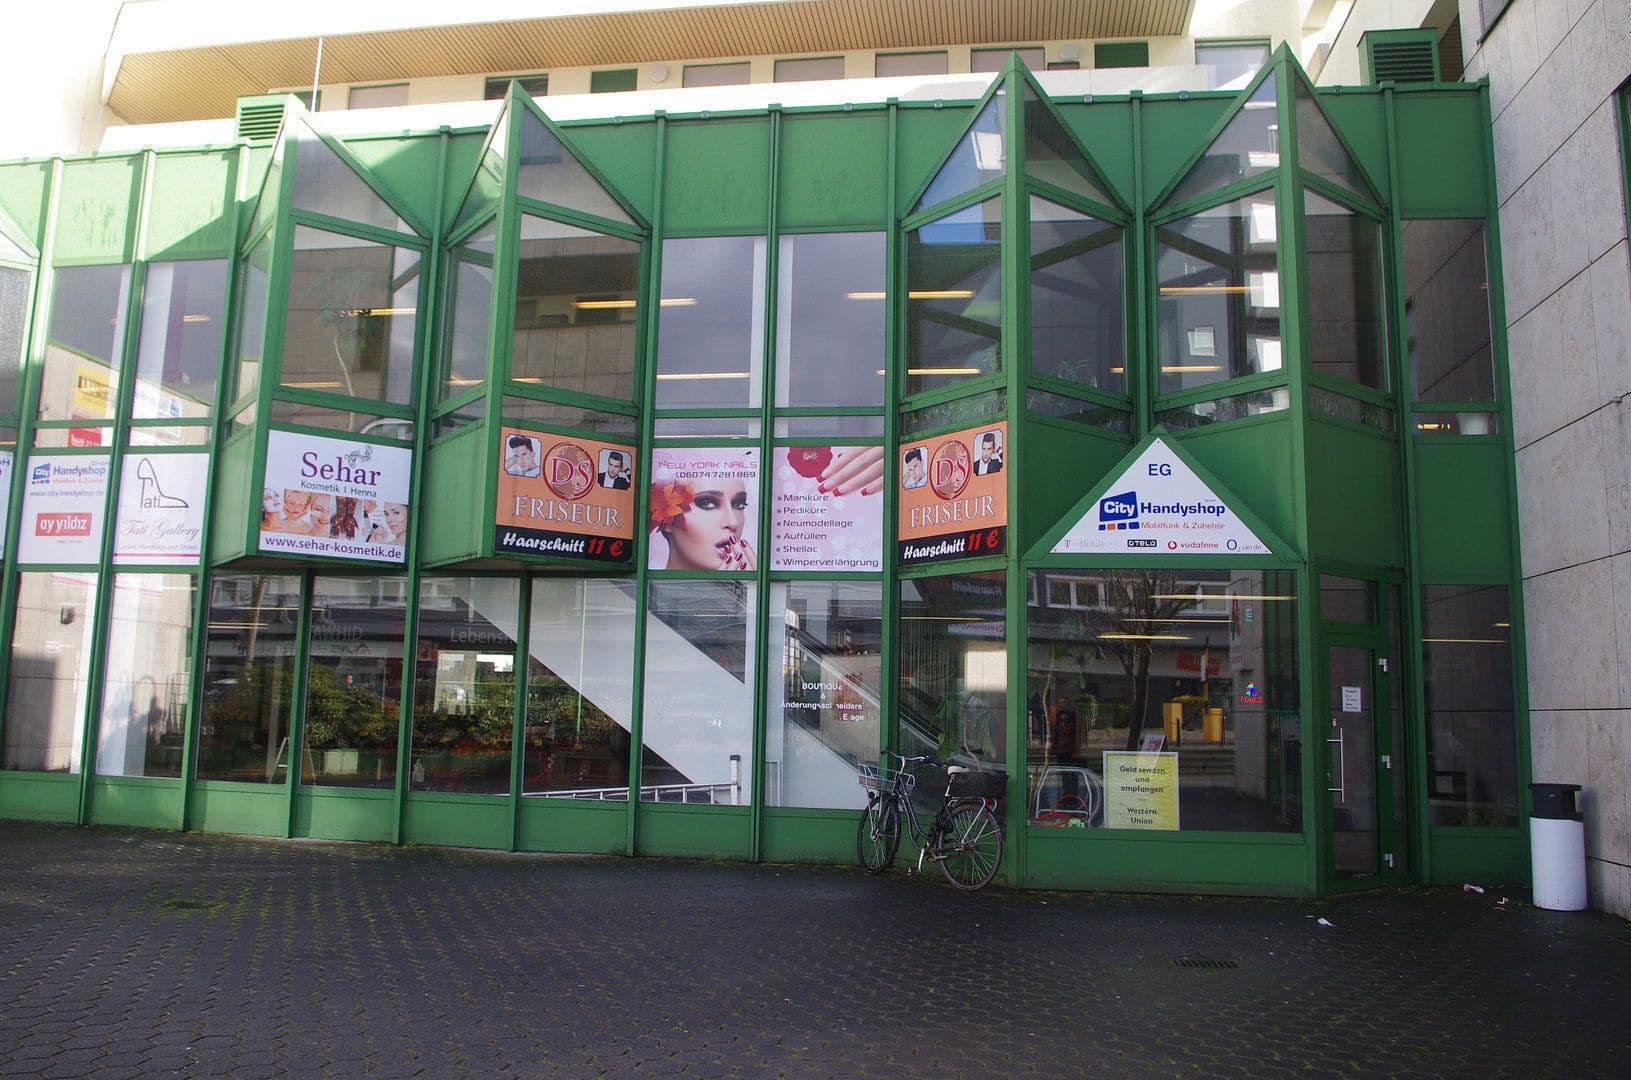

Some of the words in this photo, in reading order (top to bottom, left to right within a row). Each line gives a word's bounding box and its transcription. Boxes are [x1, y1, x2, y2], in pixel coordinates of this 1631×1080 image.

[53, 464, 106, 477] Handyshop
[301, 450, 381, 486] Sehar
[658, 461, 686, 469] NEW
[690, 461, 721, 469] YORK
[935, 455, 967, 487] DS
[1148, 463, 1172, 476] EG
[549, 457, 592, 488] DS
[300, 480, 340, 493] Kosmetik
[350, 487, 377, 498] Henna
[783, 494, 830, 502] Maniküre
[512, 495, 621, 529] FRISEUR
[783, 506, 827, 515] Pediküre
[910, 496, 996, 529] FRISEUR
[1103, 501, 1136, 518] City
[1140, 502, 1226, 517] Handyshop
[120, 520, 150, 535] Tati
[151, 519, 200, 541] Gallery
[783, 520, 854, 529] Neumodellage
[1140, 521, 1180, 530] Mobilfunk
[1183, 522, 1190, 530] &
[1191, 521, 1226, 530] Zubehör
[503, 531, 585, 553] Haarschnitt
[783, 532, 827, 540] Auffüllen
[265, 536, 402, 559] www.sehar-kosmetik.de
[783, 545, 819, 553] Shellac
[903, 538, 966, 560] Haarschnitt
[1180, 541, 1219, 549] vodafone
[782, 558, 879, 568] Wimperverlängrung
[1119, 765, 1138, 774] Geld
[1120, 785, 1165, 795] empfangen
[1126, 806, 1158, 815] Western
[1130, 817, 1154, 825] Union
